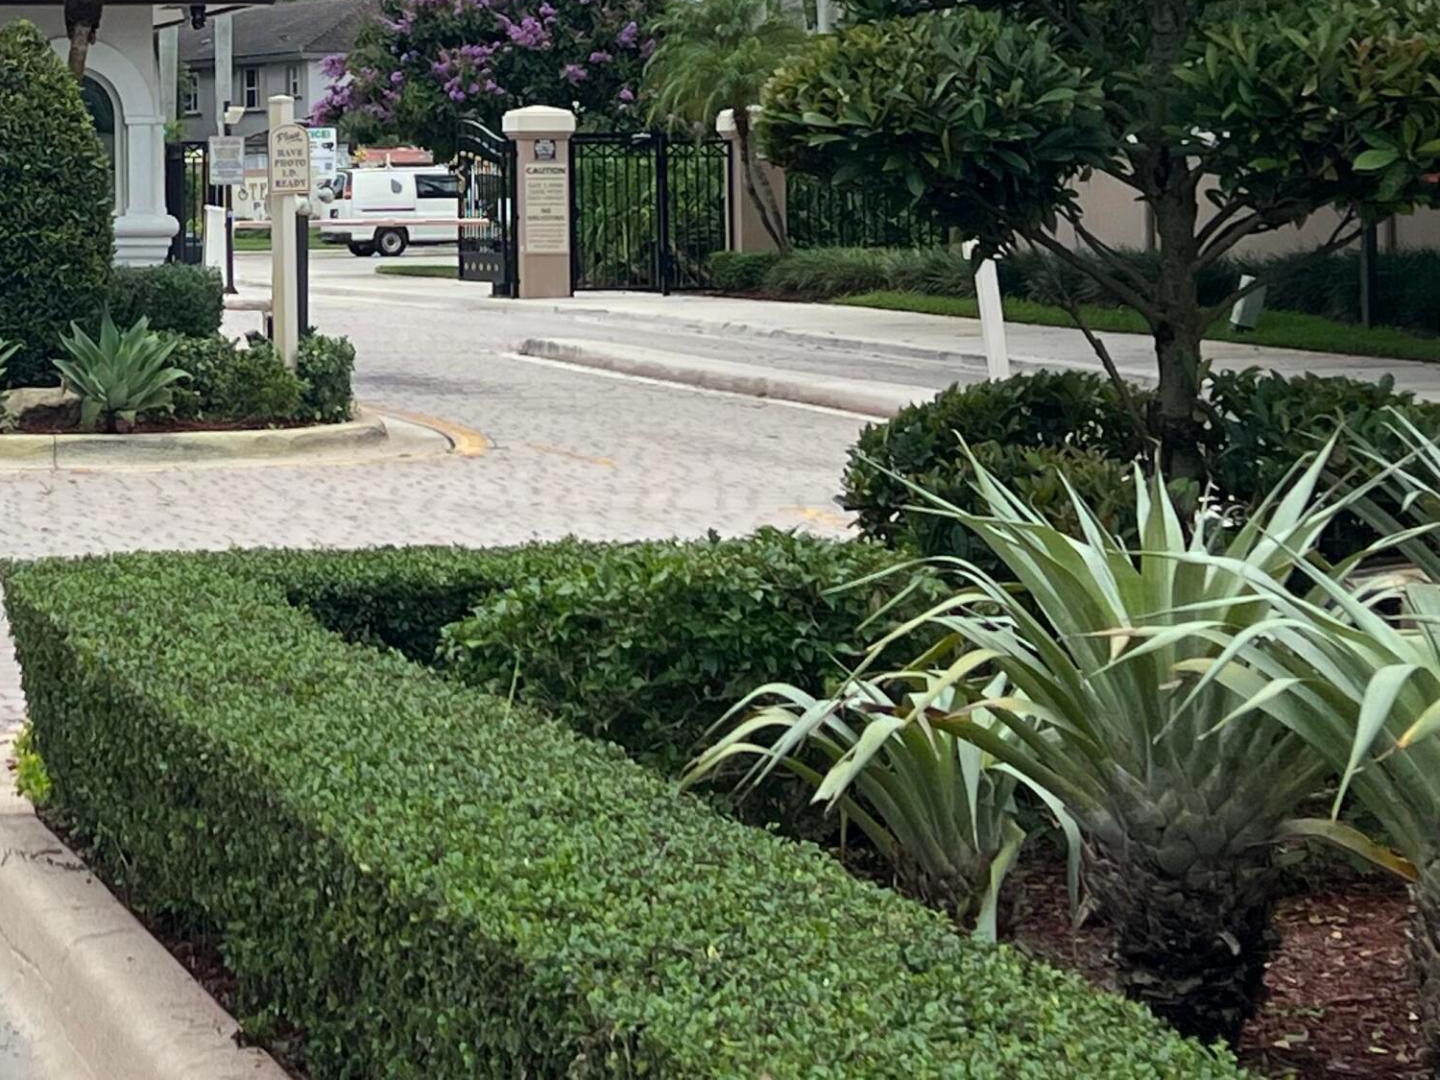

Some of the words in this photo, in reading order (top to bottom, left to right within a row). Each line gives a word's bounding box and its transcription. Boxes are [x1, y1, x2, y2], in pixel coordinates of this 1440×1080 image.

[277, 149, 303, 157] HAVE
[275, 159, 306, 167] PHOTO
[275, 179, 306, 188] READY
